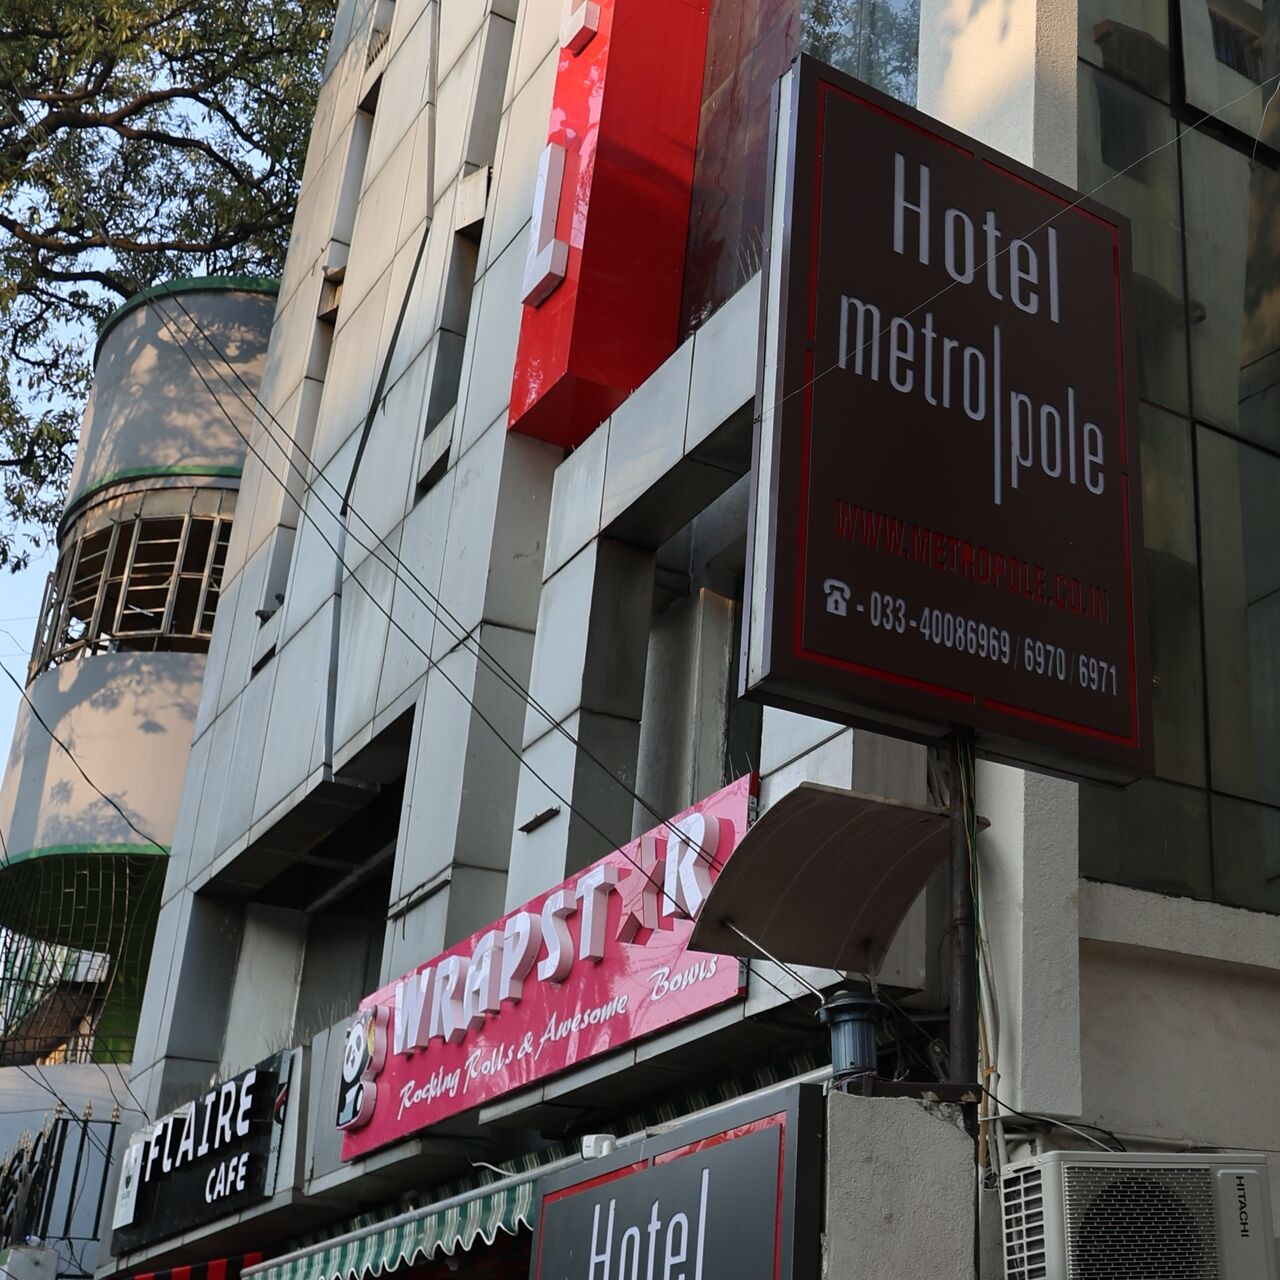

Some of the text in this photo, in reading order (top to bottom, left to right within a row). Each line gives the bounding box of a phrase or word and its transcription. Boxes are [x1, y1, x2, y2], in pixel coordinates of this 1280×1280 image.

[892, 151, 1062, 324] Hotel
[398, 955, 719, 1120] Rocking Rolls & Awesome Bowls
[144, 1069, 257, 1183] FLAIRE
[204, 1152, 250, 1204] CAFE
[1235, 1175, 1250, 1238] HITACHI
